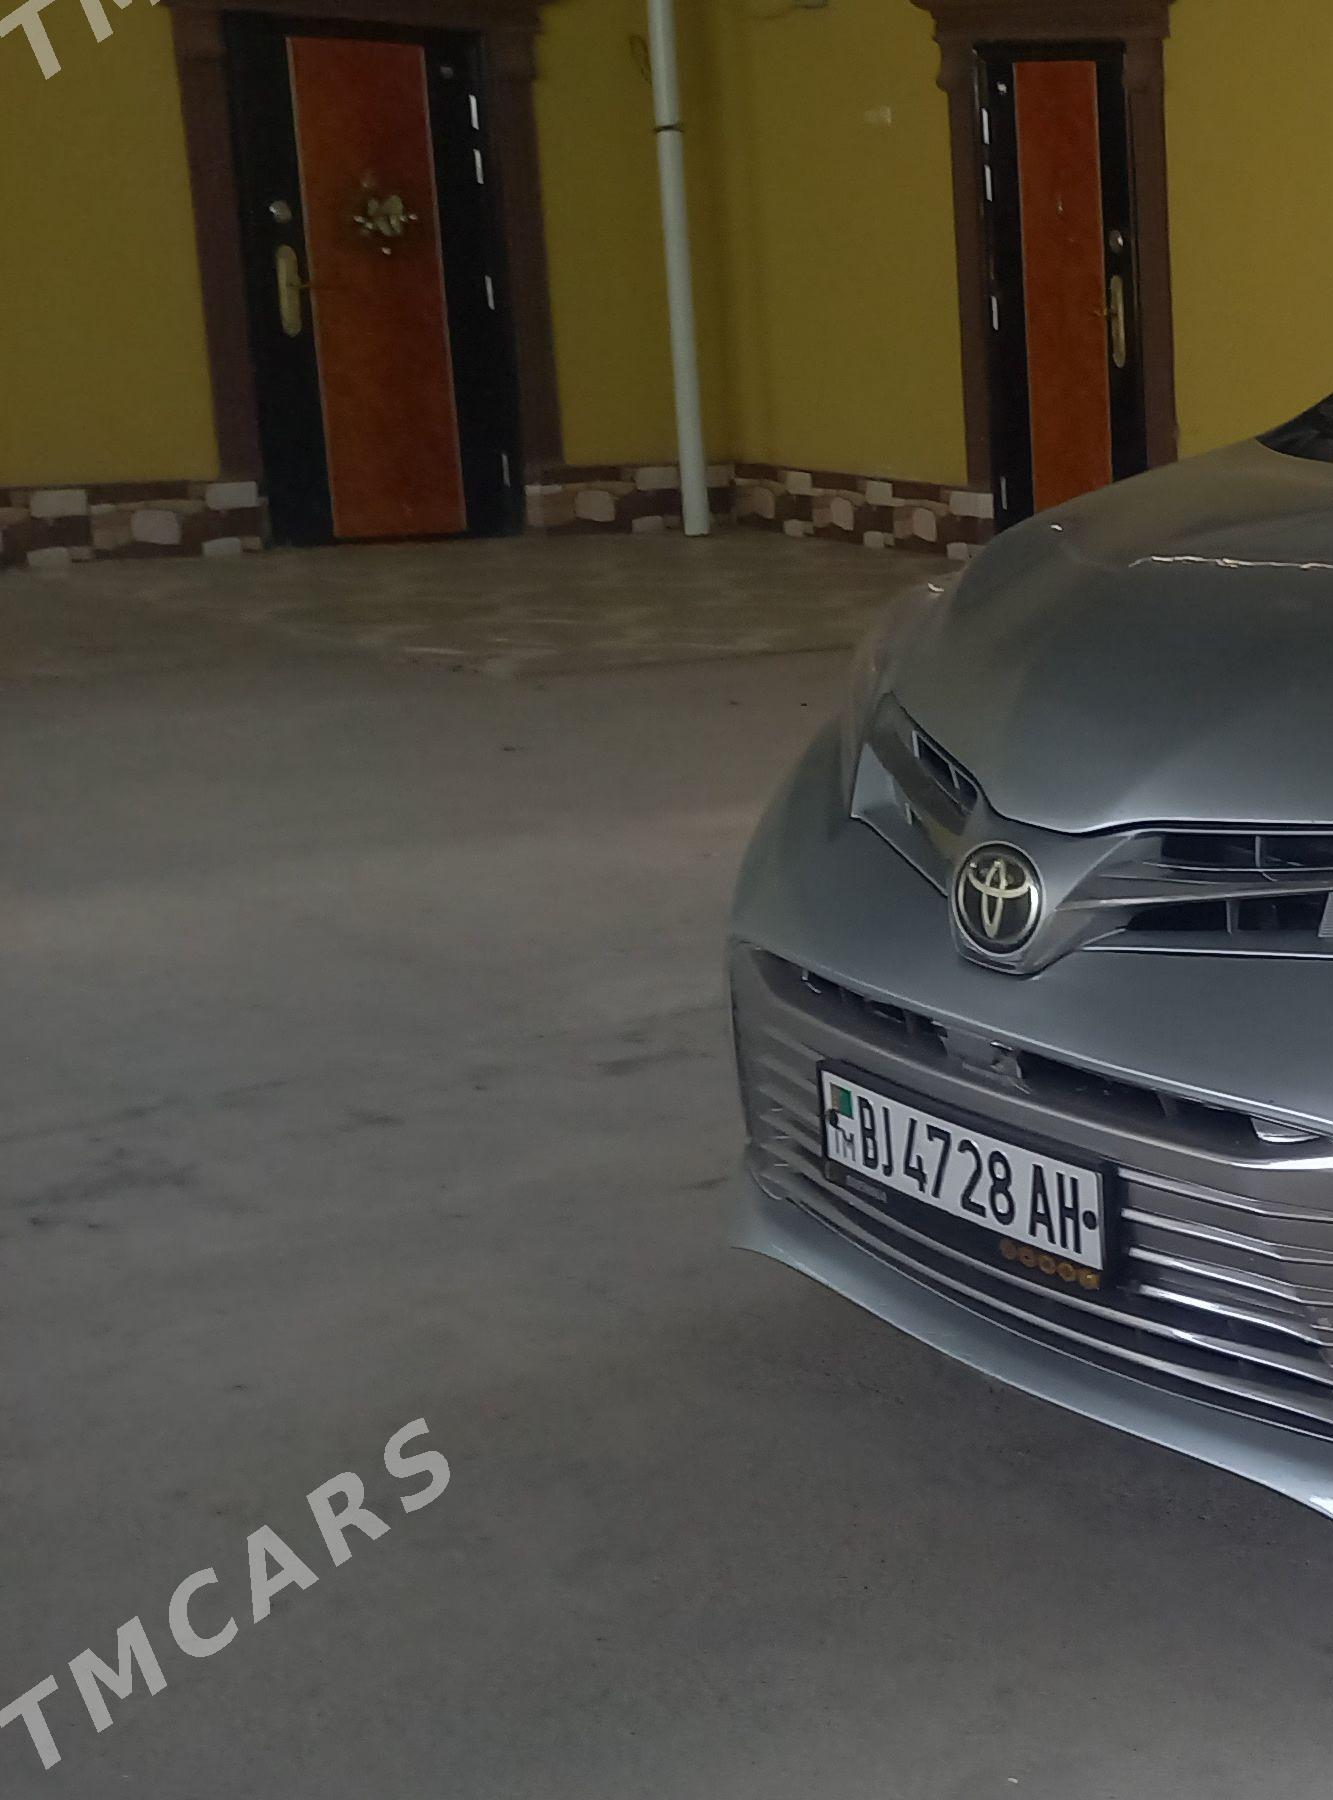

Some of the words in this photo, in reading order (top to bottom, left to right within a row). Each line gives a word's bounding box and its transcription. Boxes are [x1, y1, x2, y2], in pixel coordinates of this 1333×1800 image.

[856, 1095, 894, 1178] BJ
[903, 1117, 1016, 1226] 4728
[1028, 1163, 1082, 1255] AH
